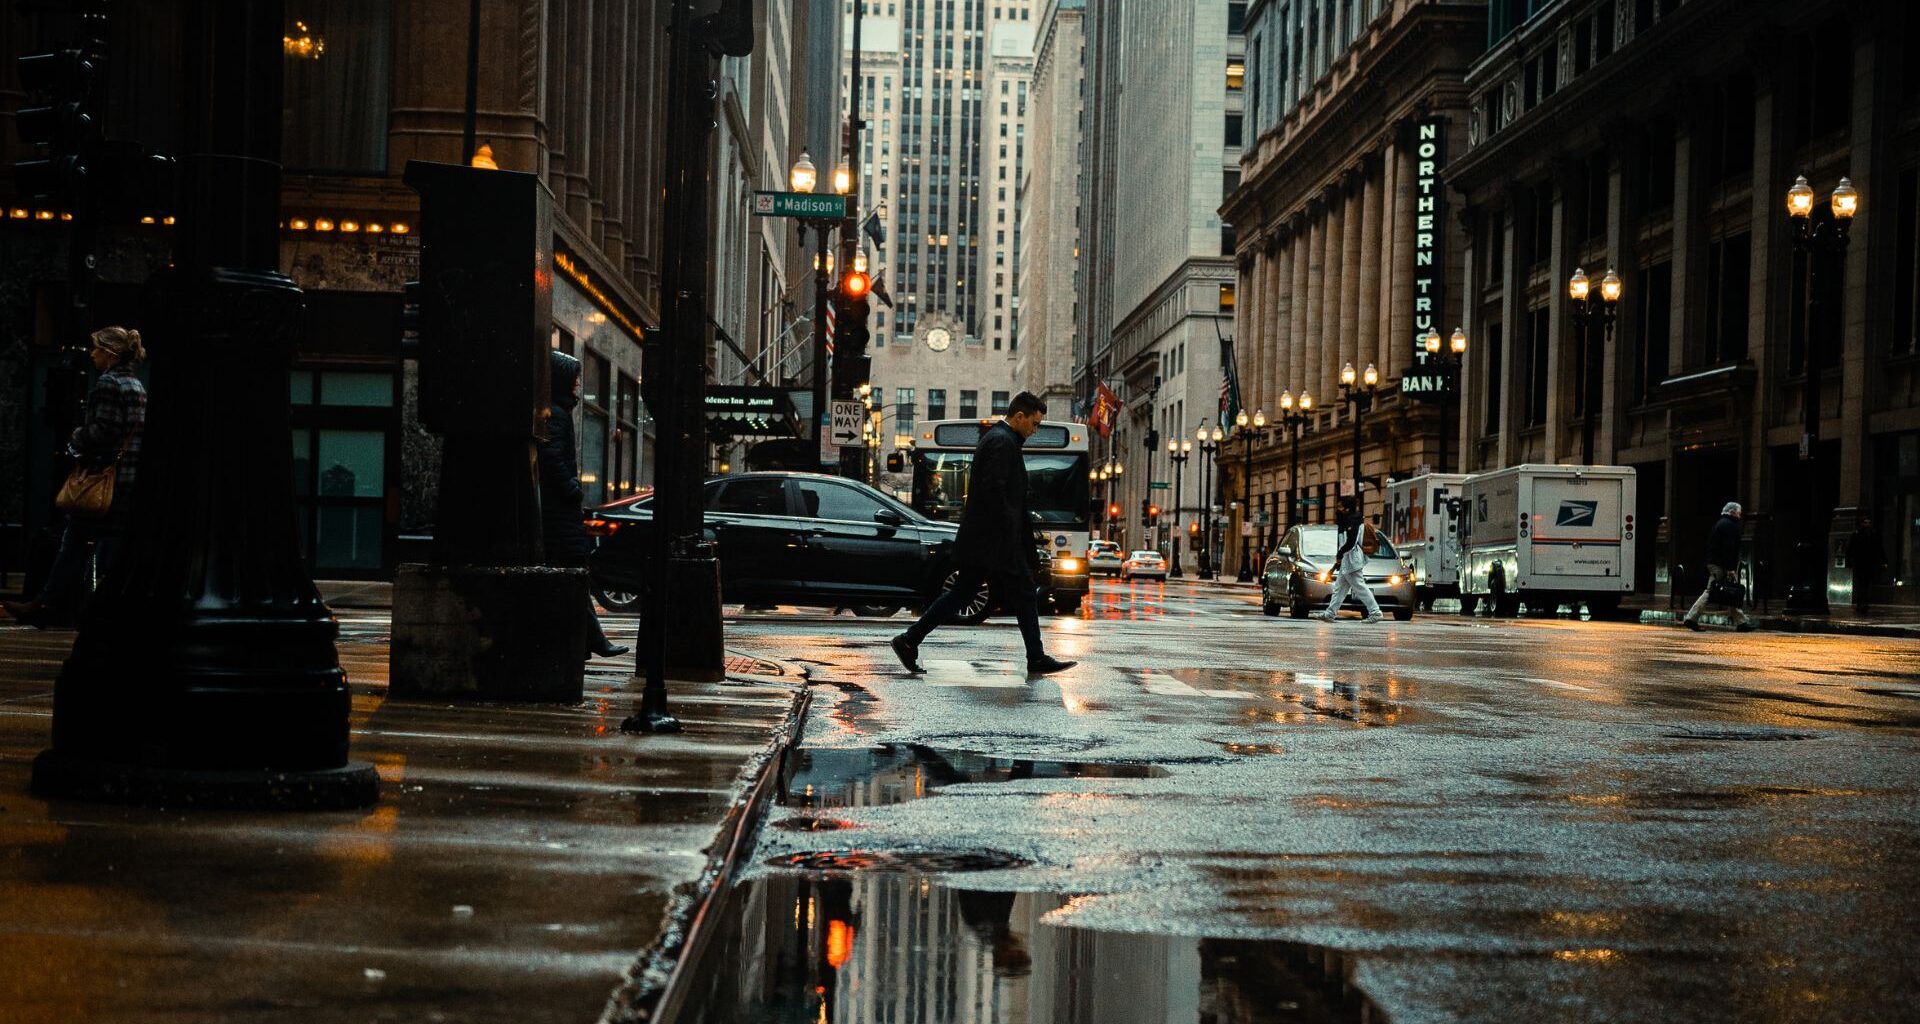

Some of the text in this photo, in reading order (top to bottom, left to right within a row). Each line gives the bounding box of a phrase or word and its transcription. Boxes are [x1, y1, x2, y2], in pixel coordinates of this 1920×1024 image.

[784, 198, 832, 212] Madison
[1415, 124, 1436, 365] NORTHERN TRUST
[704, 396, 730, 404] idence
[731, 397, 744, 405] Inn
[835, 404, 861, 416] ONE
[834, 416, 861, 428] WAY
